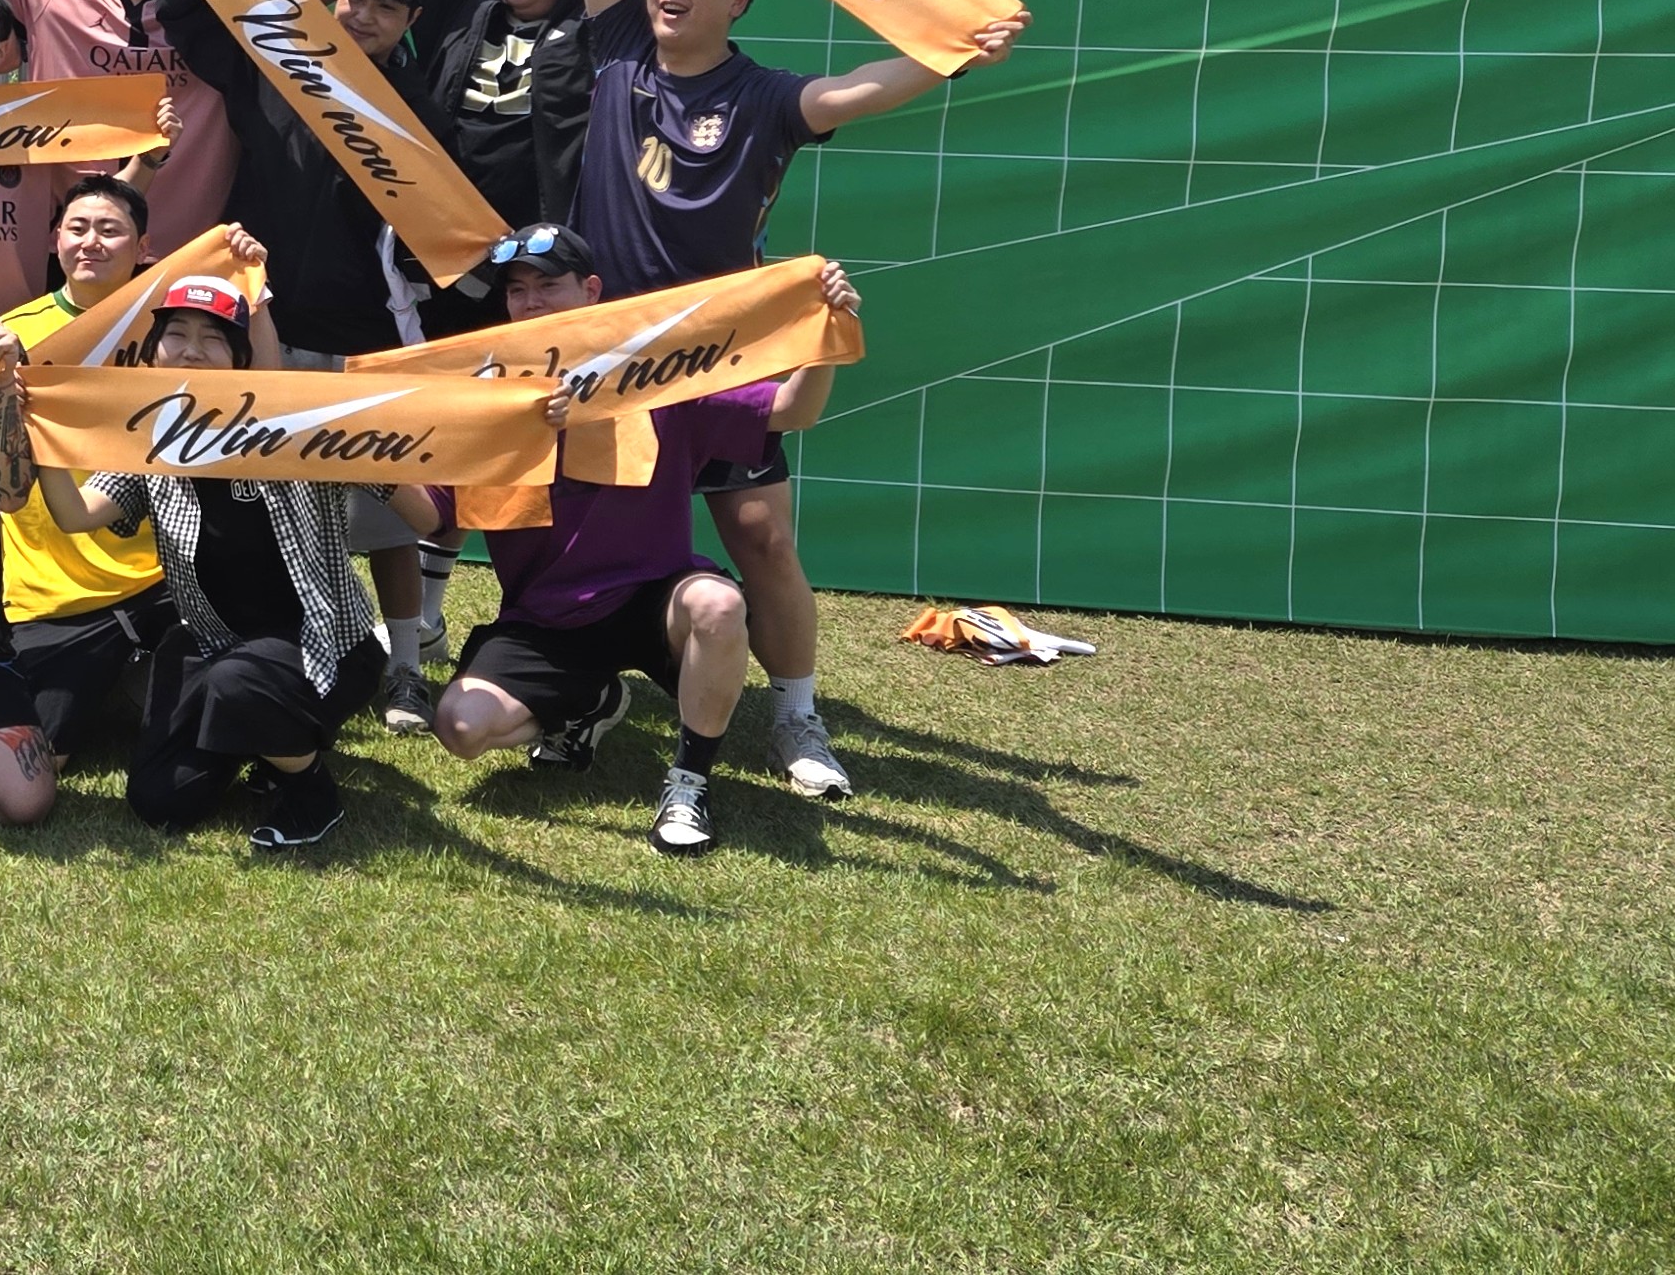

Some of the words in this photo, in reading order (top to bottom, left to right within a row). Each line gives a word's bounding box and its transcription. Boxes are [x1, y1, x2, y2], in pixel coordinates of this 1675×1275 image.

[89, 45, 187, 73] QATAR
[321, 110, 418, 199] now.
[637, 135, 673, 193] 10
[616, 328, 743, 397] now.
[126, 383, 289, 465] Win
[299, 424, 436, 465] now.
